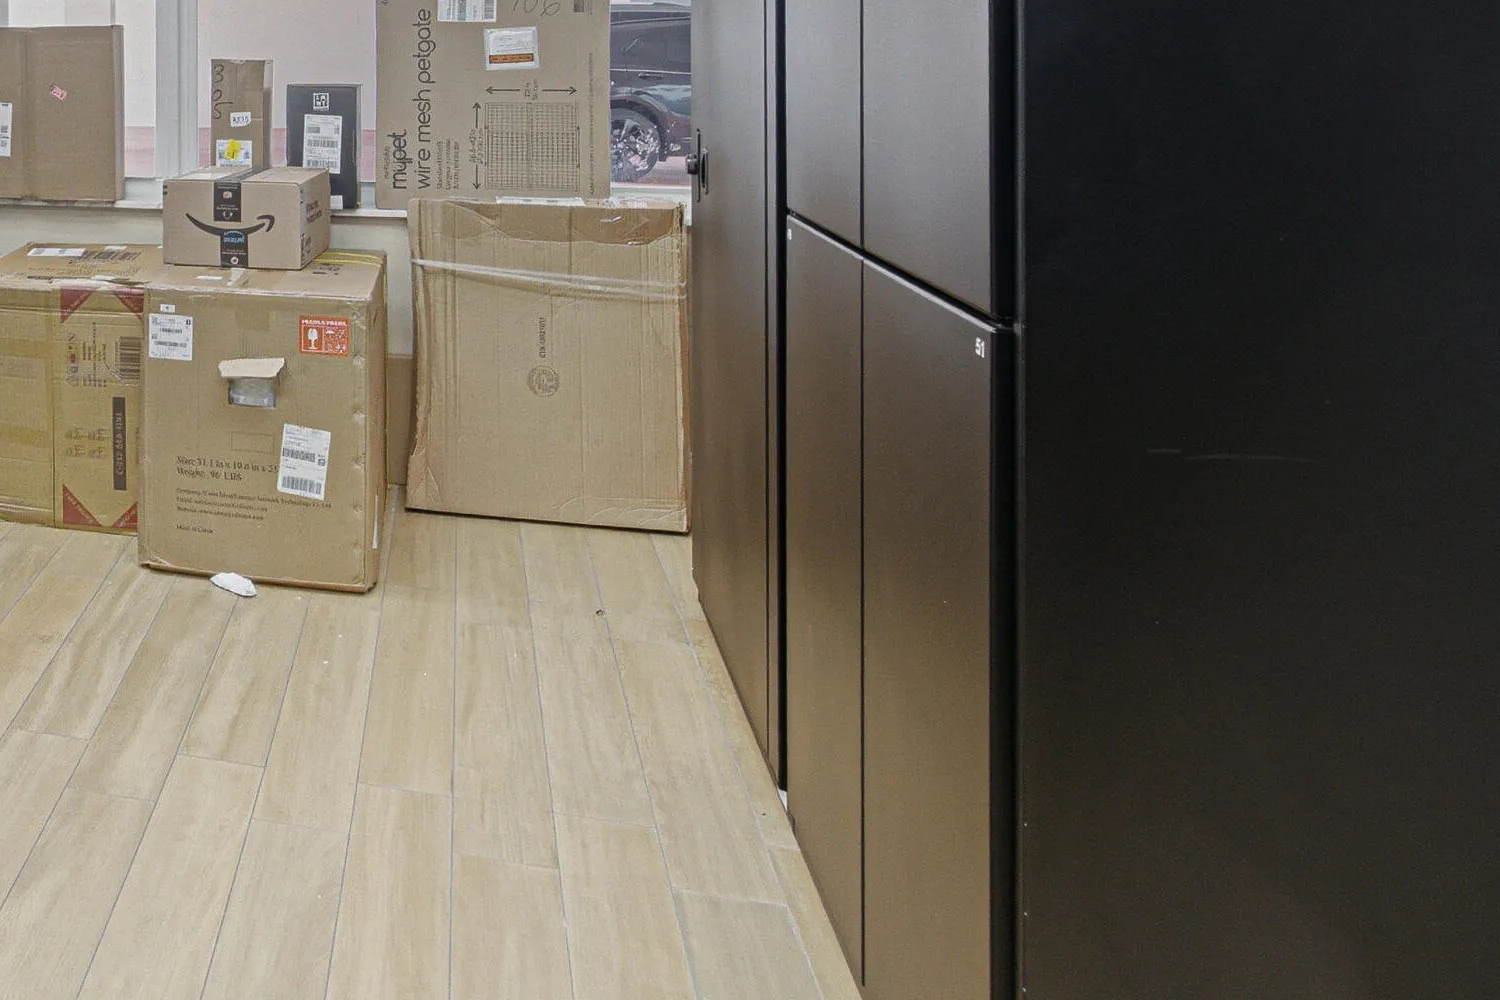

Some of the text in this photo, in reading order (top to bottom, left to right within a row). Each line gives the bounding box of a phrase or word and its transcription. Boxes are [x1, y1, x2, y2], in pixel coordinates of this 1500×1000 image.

[412, 8, 437, 190] wire mesh petgate
[387, 129, 413, 190] mypet
[975, 337, 985, 358] 51
